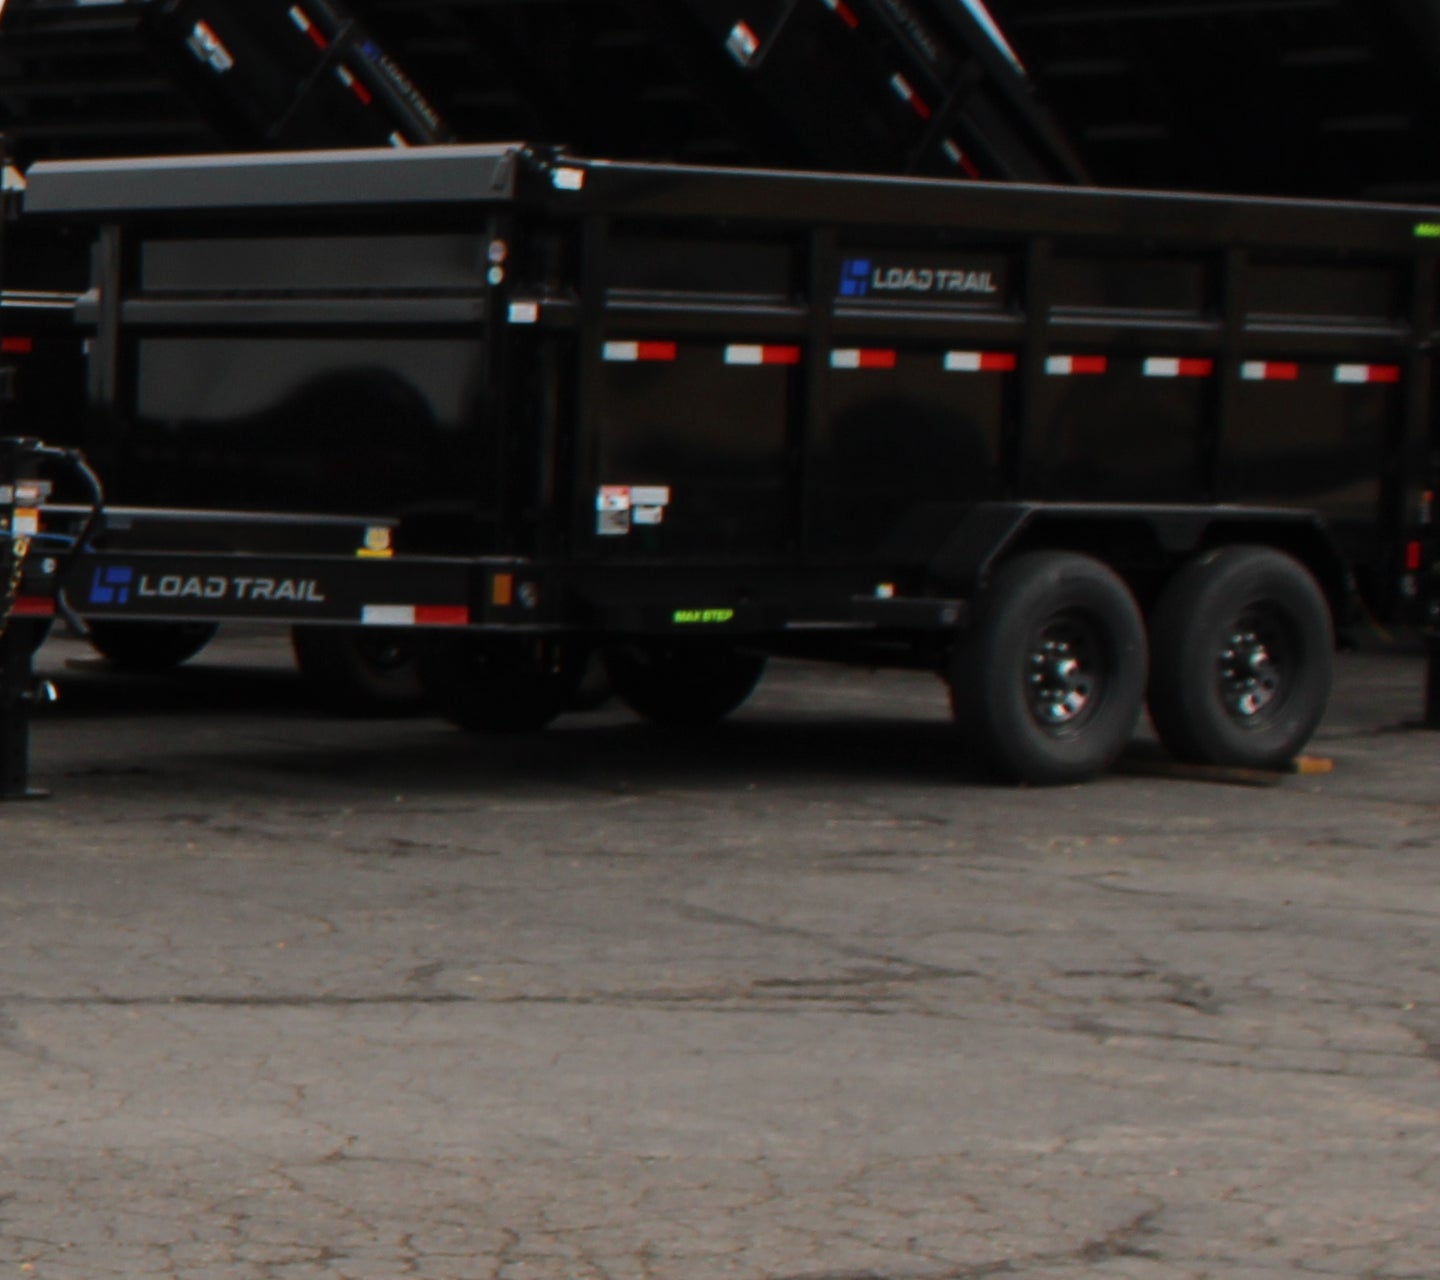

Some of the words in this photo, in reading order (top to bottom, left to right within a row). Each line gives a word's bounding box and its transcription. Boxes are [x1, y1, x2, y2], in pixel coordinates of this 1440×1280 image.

[872, 267, 932, 290] LOAD
[935, 269, 997, 293] TRAIL
[137, 574, 228, 599] LOAD
[233, 576, 326, 602] TRAIL
